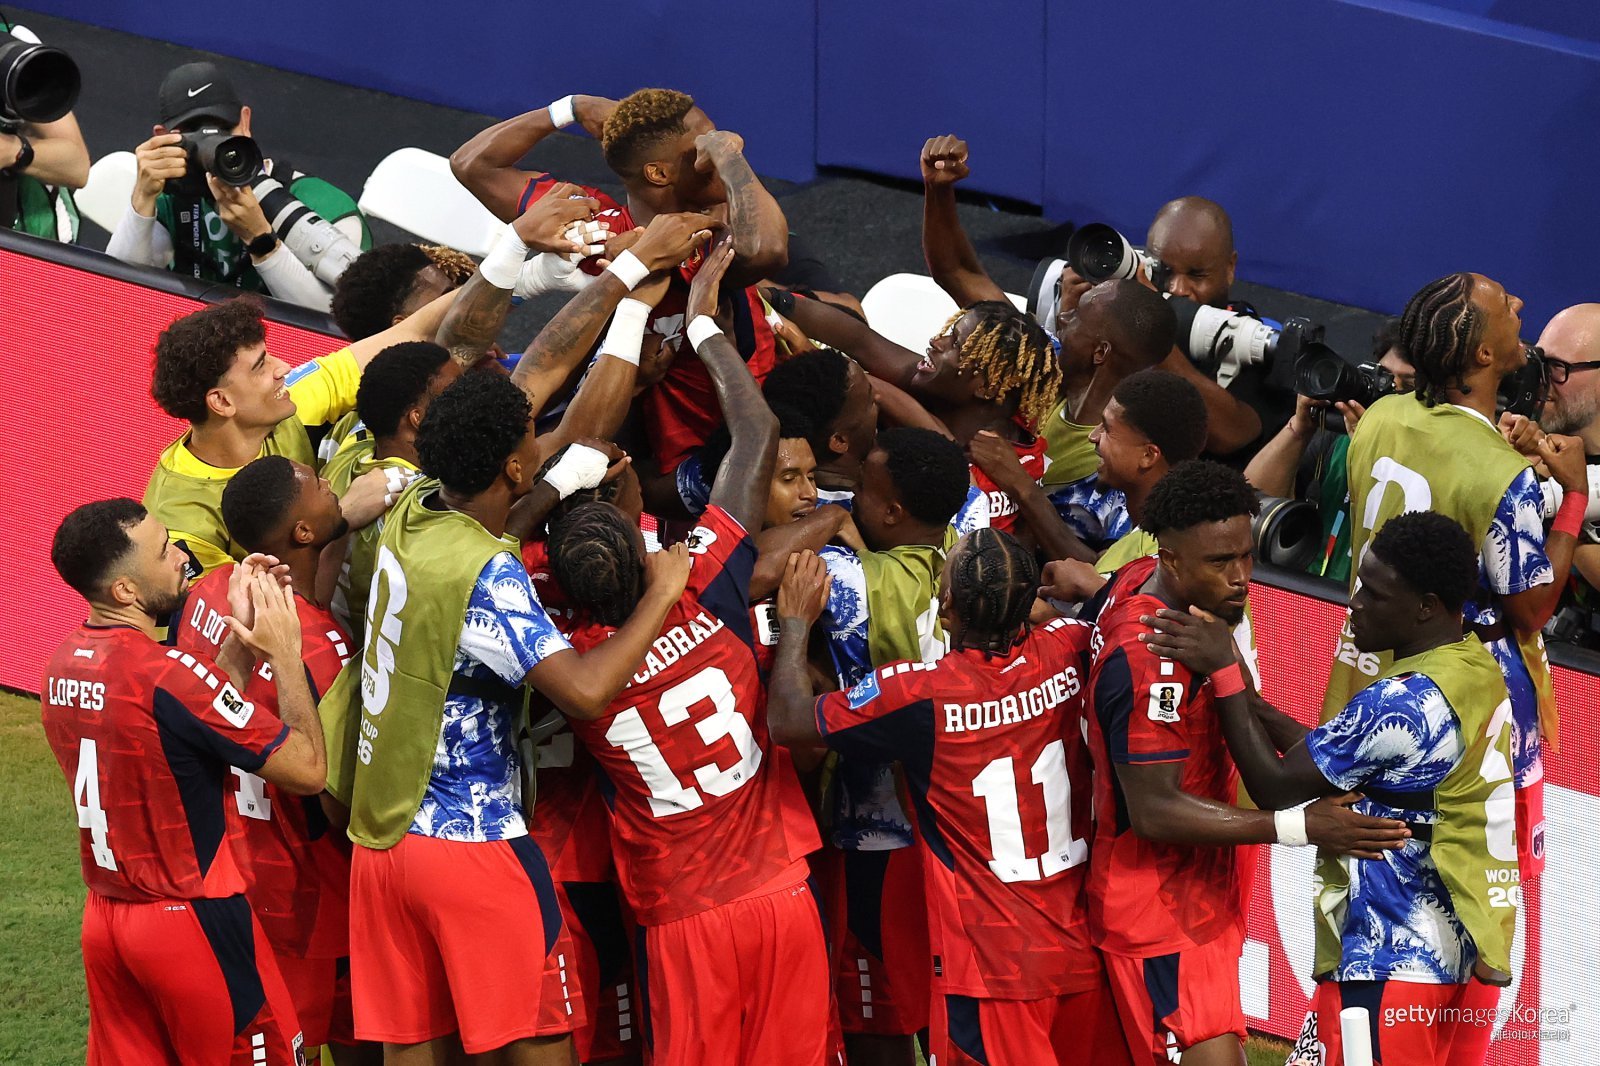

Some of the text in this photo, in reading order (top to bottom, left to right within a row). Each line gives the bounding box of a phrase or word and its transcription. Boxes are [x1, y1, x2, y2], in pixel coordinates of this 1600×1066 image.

[49, 676, 106, 711] LOPES
[363, 667, 376, 698] FIFA
[943, 666, 1081, 733] RODRIGUES
[363, 718, 379, 741] CUP
[604, 666, 763, 818] 13
[74, 737, 119, 872] 4
[971, 738, 1088, 883] 11
